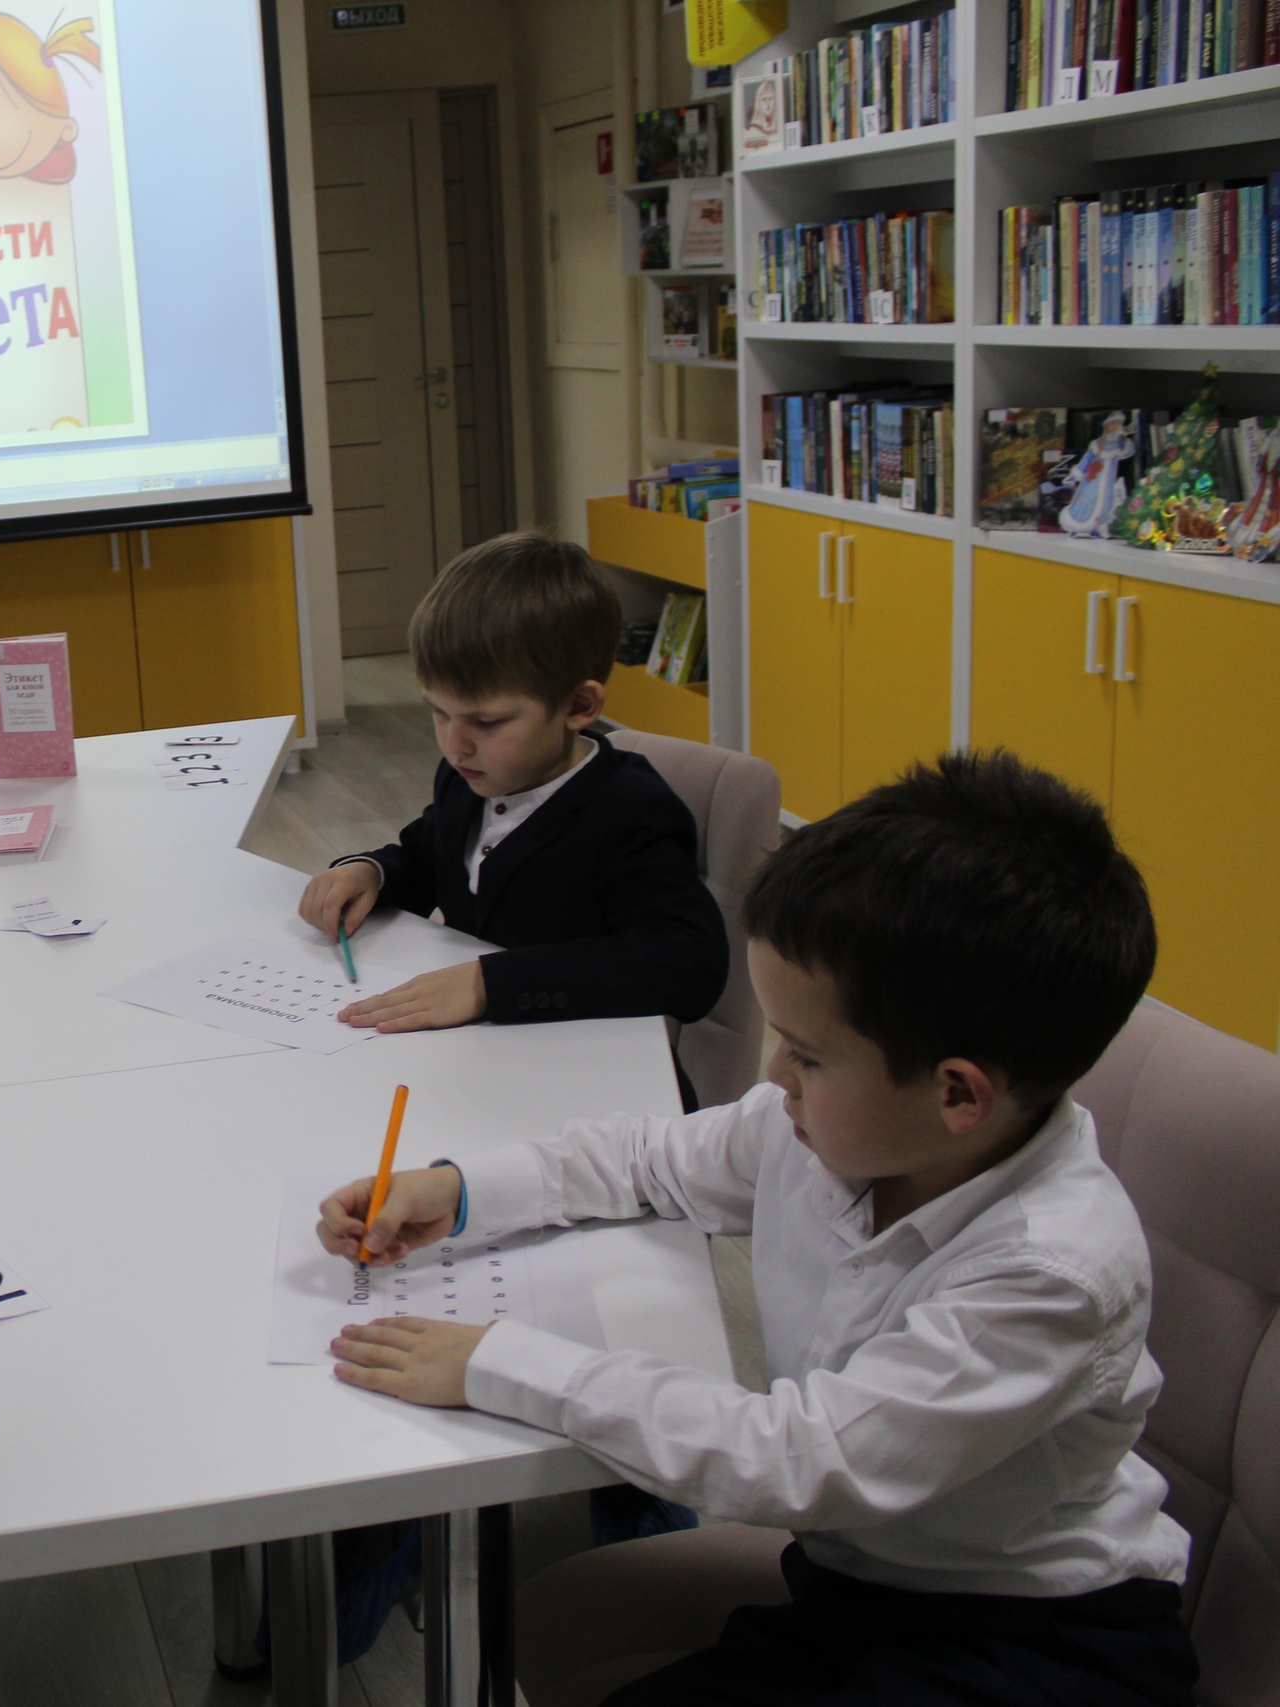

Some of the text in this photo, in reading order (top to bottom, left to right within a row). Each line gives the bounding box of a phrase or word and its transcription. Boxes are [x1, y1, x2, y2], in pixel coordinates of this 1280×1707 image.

[336, 6, 400, 26] ВЫХОД
[1092, 69, 1115, 94] М
[4, 672, 44, 683] Этикет
[205, 993, 305, 1024] Головоломка
[347, 1268, 369, 1306] Голов
